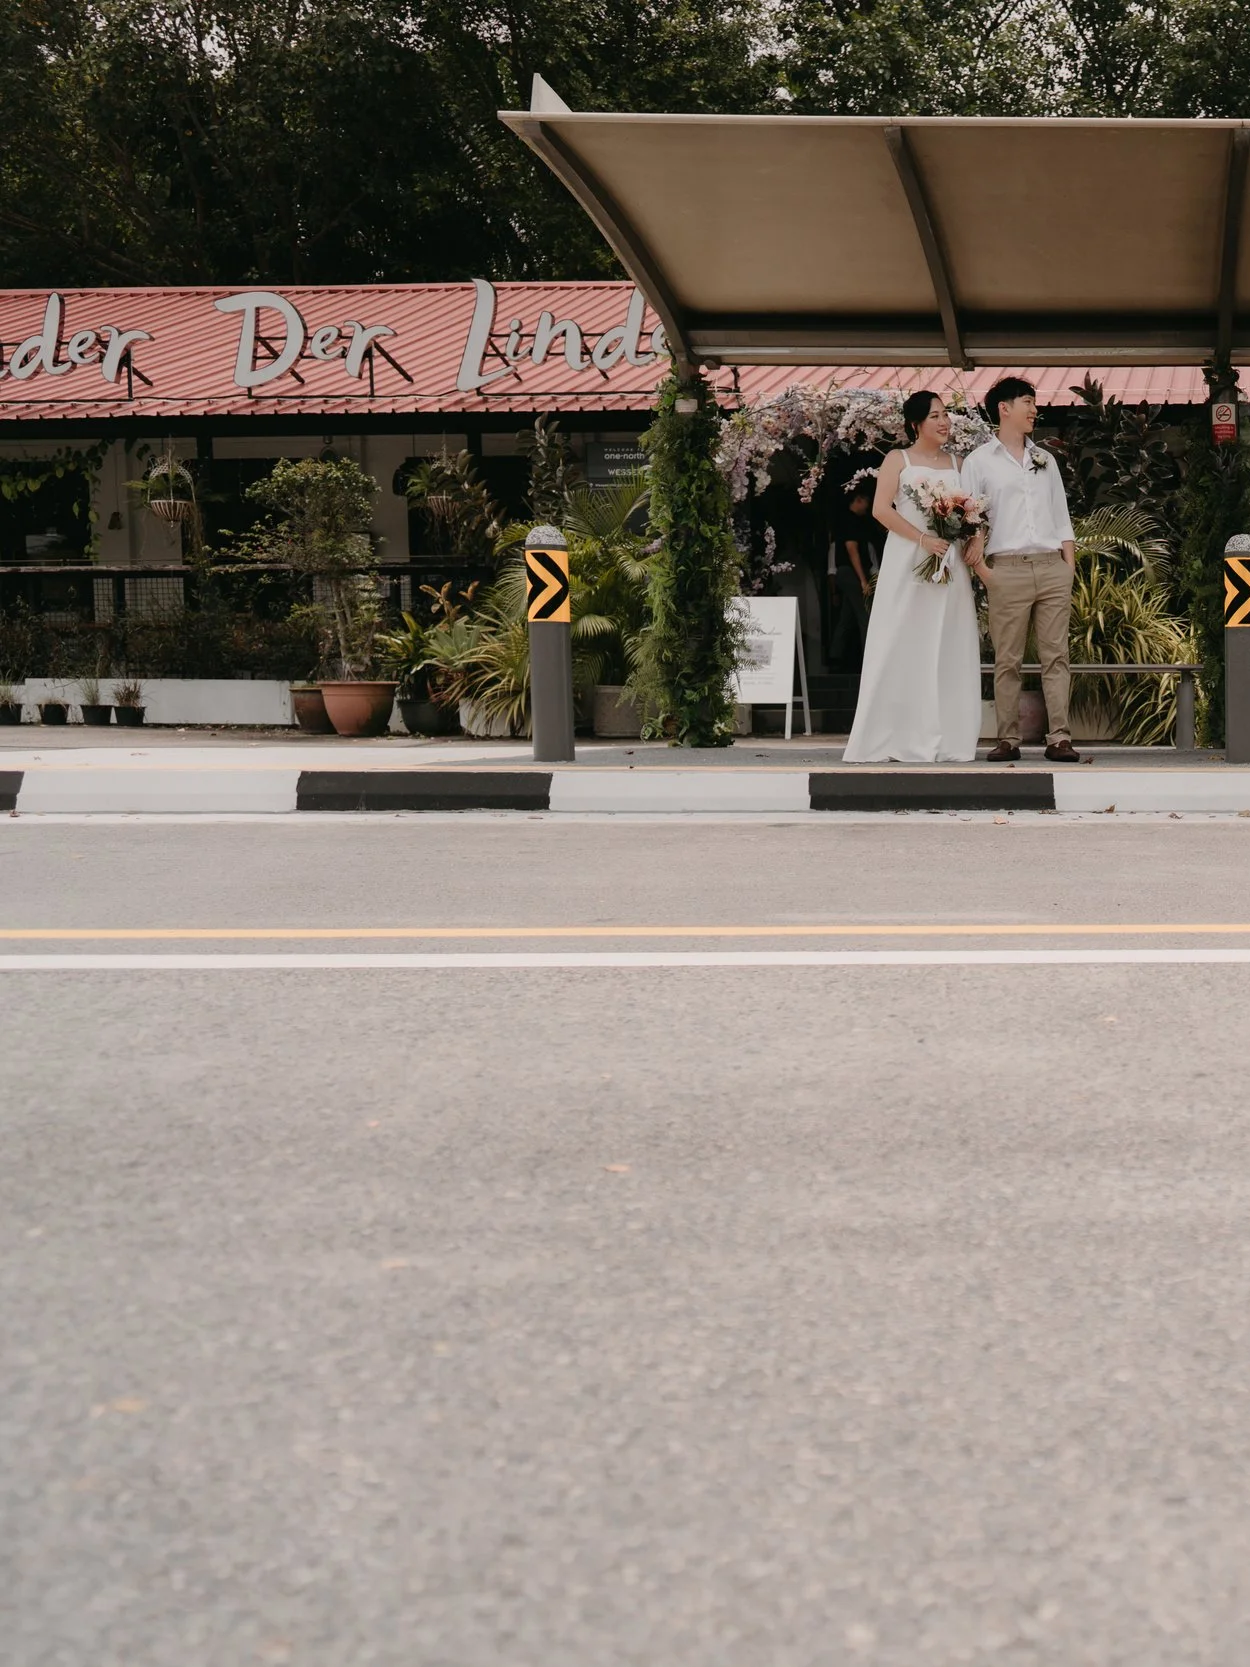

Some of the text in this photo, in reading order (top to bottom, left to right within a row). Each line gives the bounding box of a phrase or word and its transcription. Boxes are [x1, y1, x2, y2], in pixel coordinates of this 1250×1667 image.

[0, 291, 155, 385] der
[214, 290, 397, 389] Der
[604, 452, 645, 460] one-north
